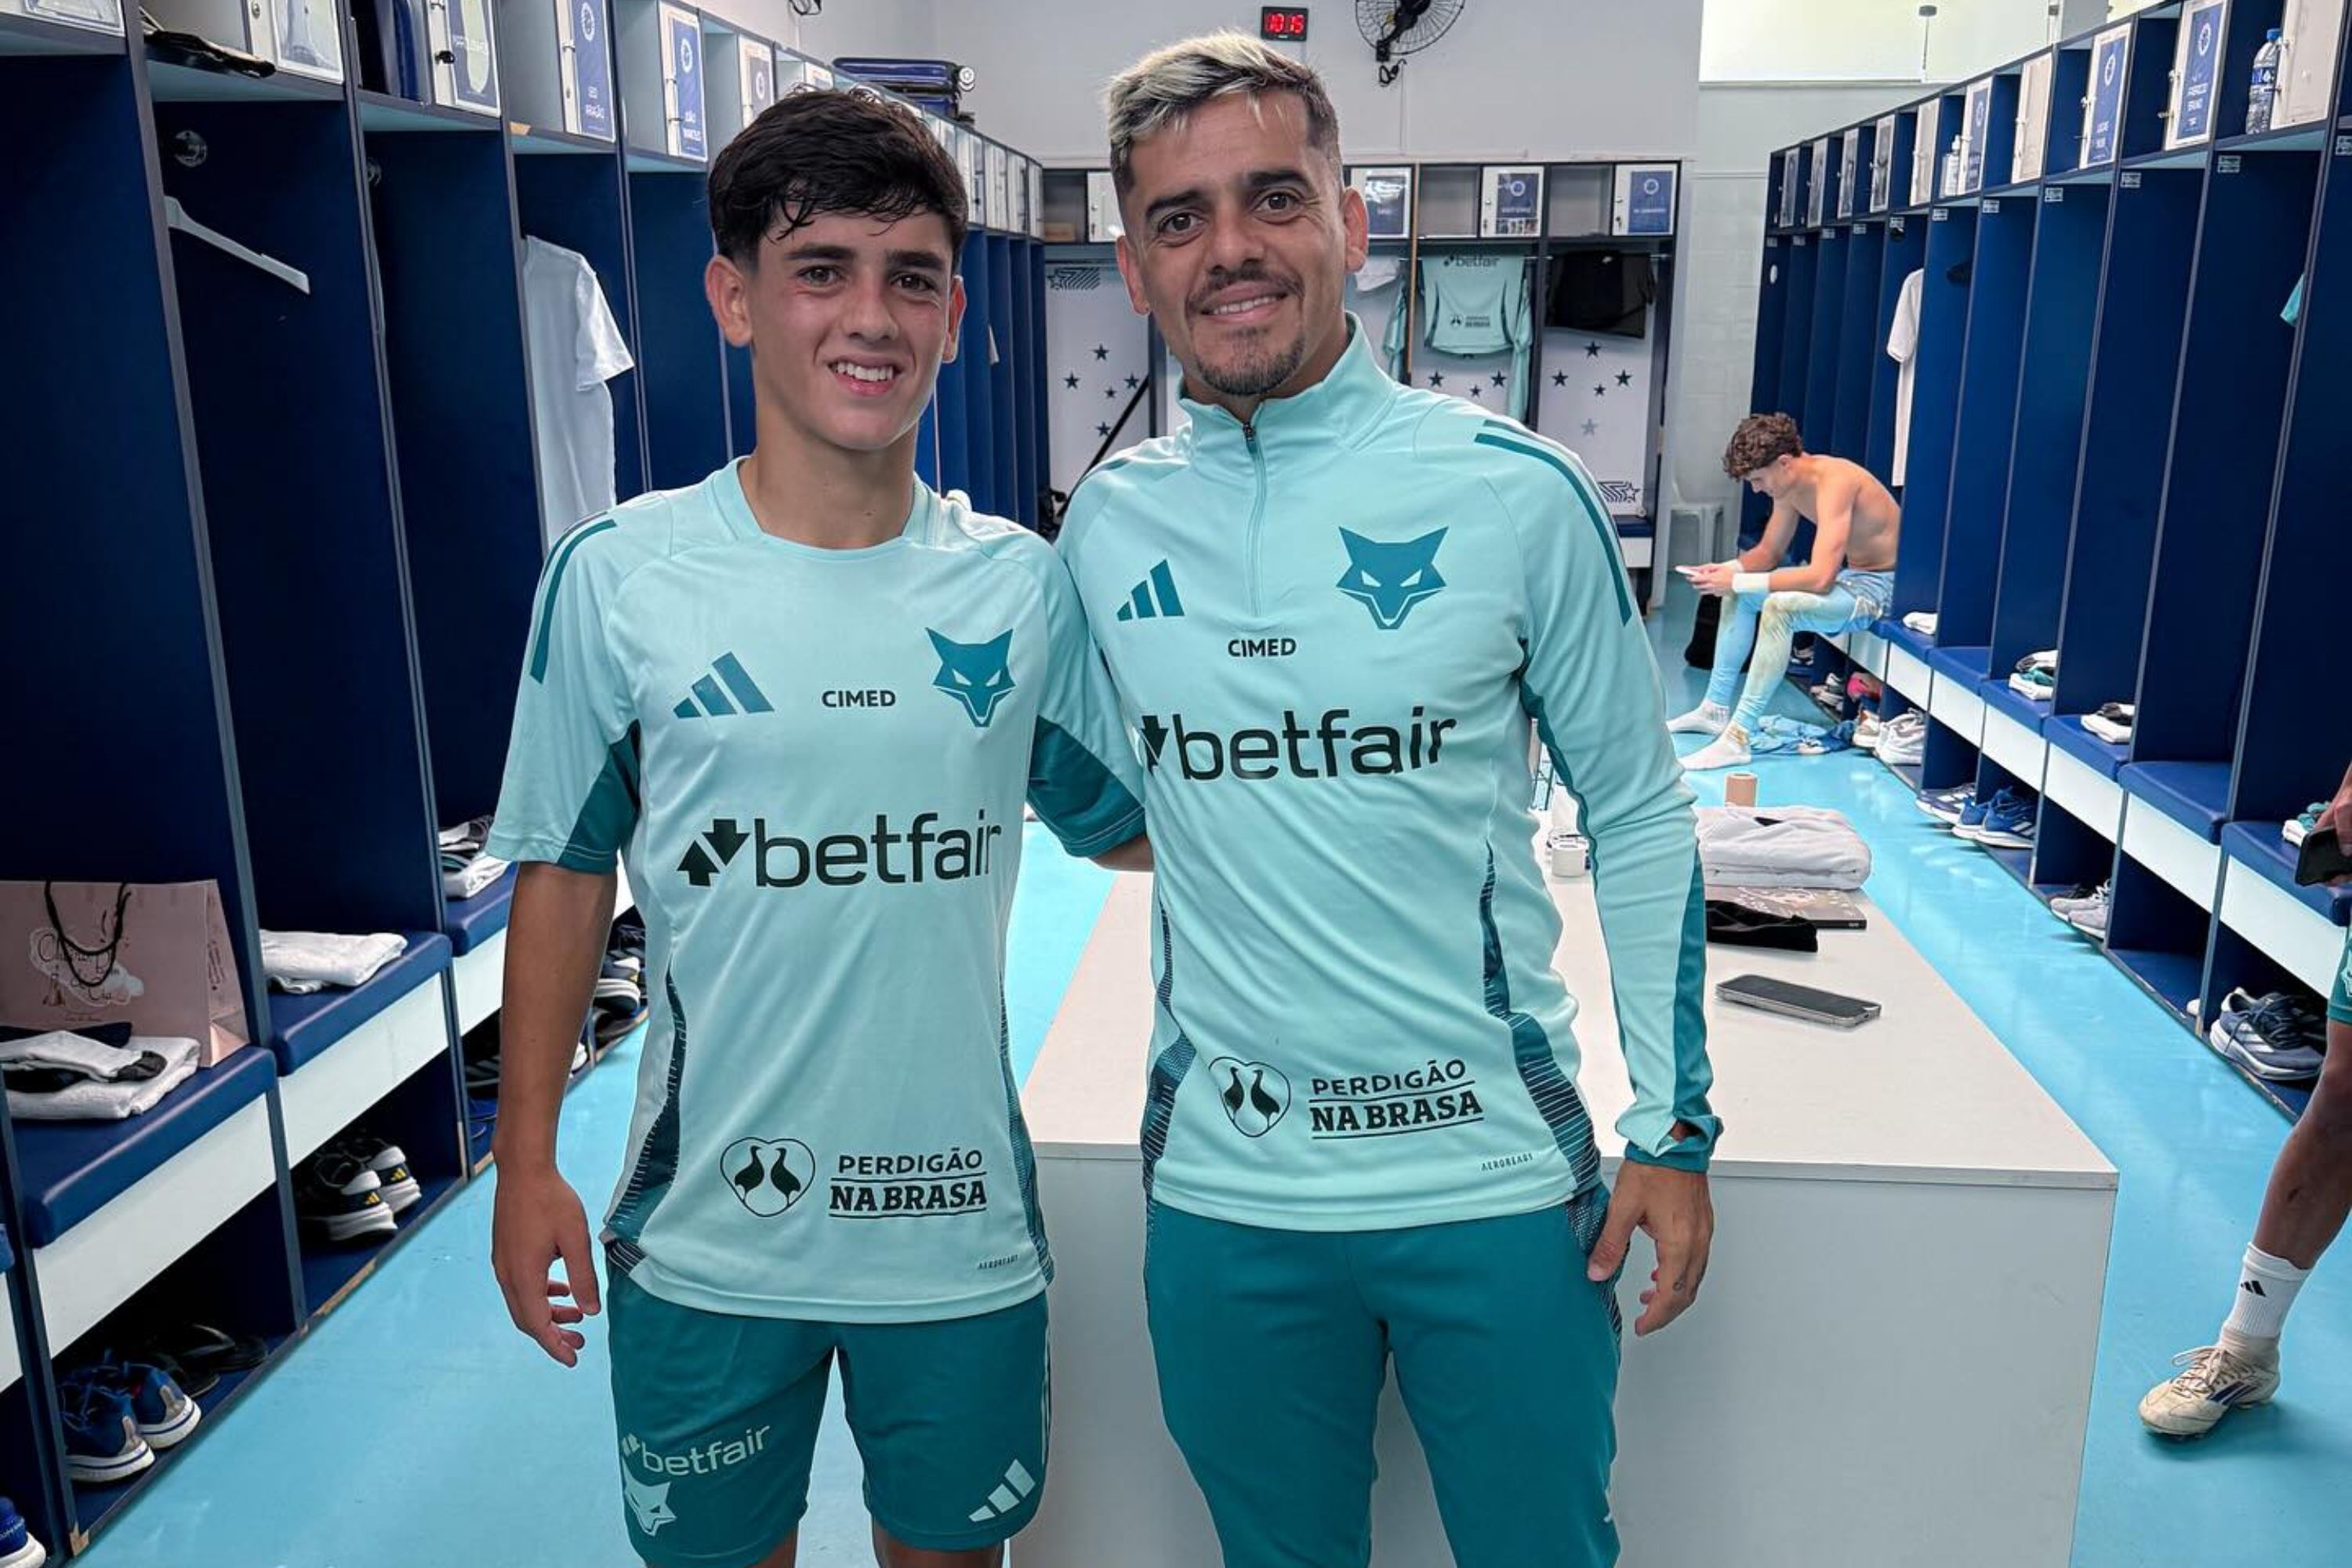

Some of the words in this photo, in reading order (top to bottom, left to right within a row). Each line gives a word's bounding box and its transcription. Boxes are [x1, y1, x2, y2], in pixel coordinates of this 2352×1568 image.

[1228, 637, 1297, 658] CIMED
[821, 690, 897, 708] CIMED
[1172, 706, 1457, 781] betfair
[753, 808, 1002, 888] betfair
[1312, 1058, 1467, 1096] PERDIGÃO
[1309, 1106, 1361, 1132] NA
[1366, 1090, 1483, 1131] BRASA
[838, 1147, 982, 1175] PERDIGÃO
[829, 1185, 878, 1211] NA
[882, 1180, 988, 1211] BRASA
[641, 1425, 771, 1476] betfair
